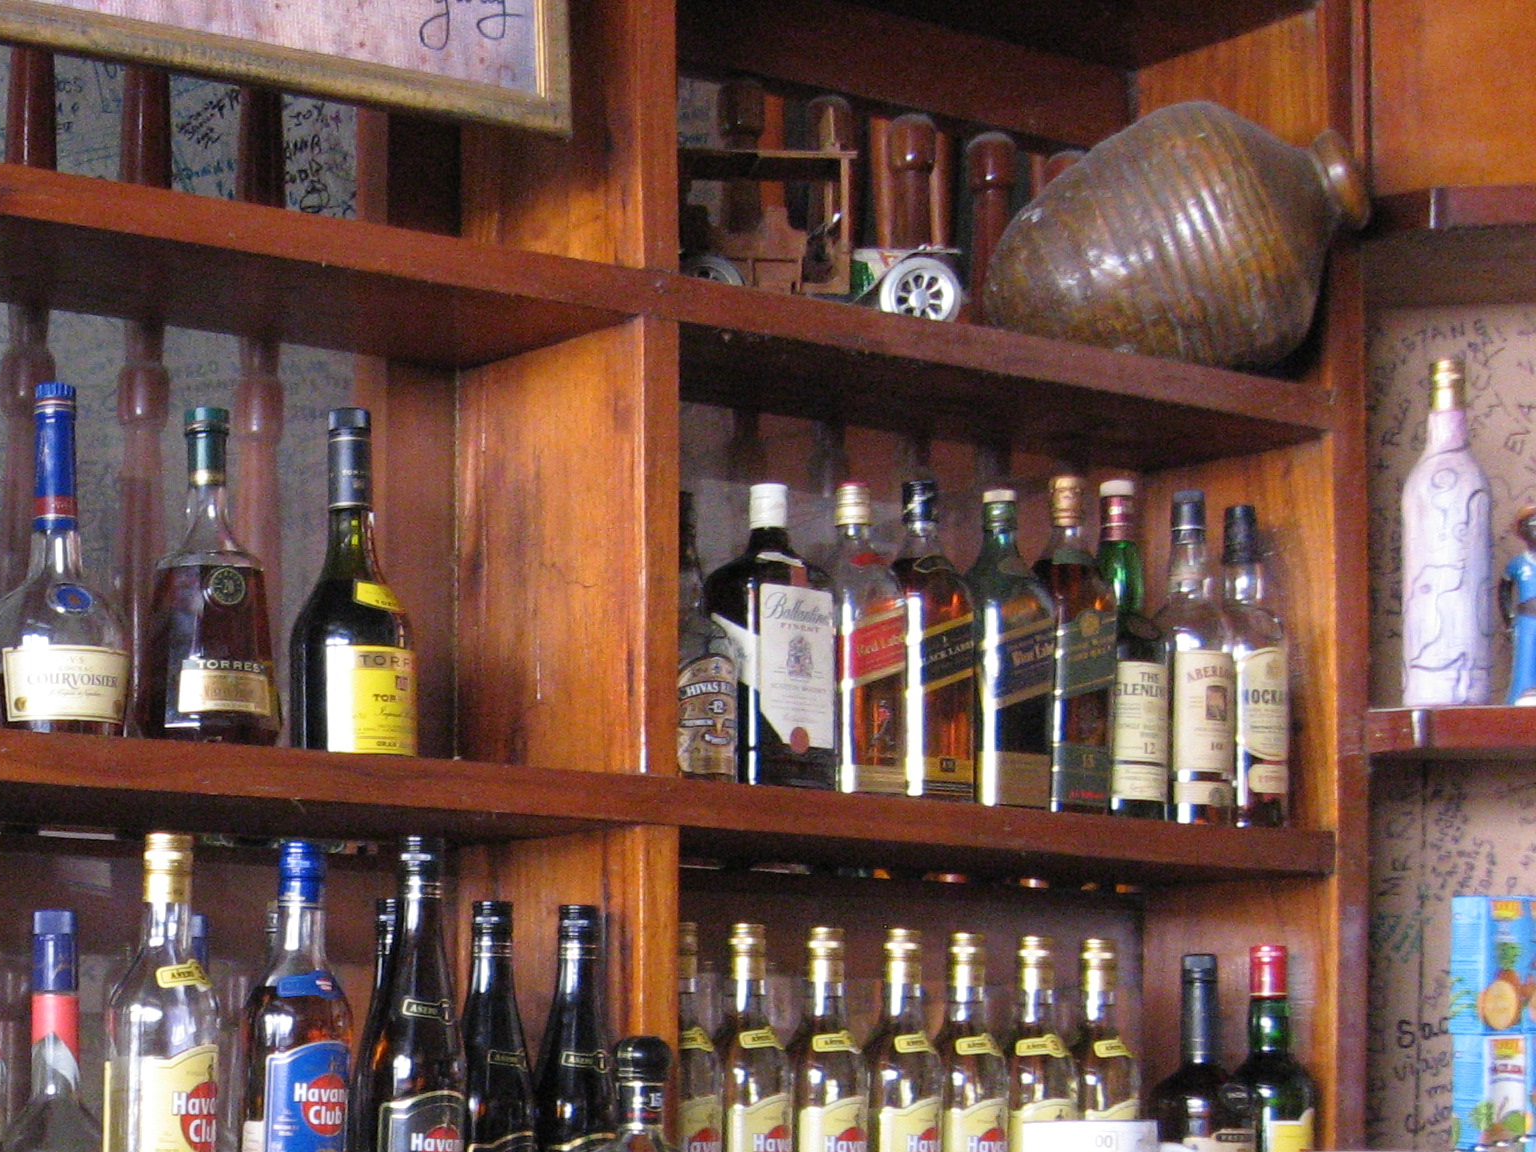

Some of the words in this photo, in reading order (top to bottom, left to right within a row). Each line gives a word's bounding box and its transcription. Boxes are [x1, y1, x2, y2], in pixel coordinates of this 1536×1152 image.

[196, 659, 263, 673] TORRES
[27, 672, 117, 688] COURVOISIER
[1139, 671, 1160, 683] THE
[1186, 665, 1227, 683] ABERL
[1143, 742, 1156, 754] 12
[308, 1105, 342, 1126] Club
